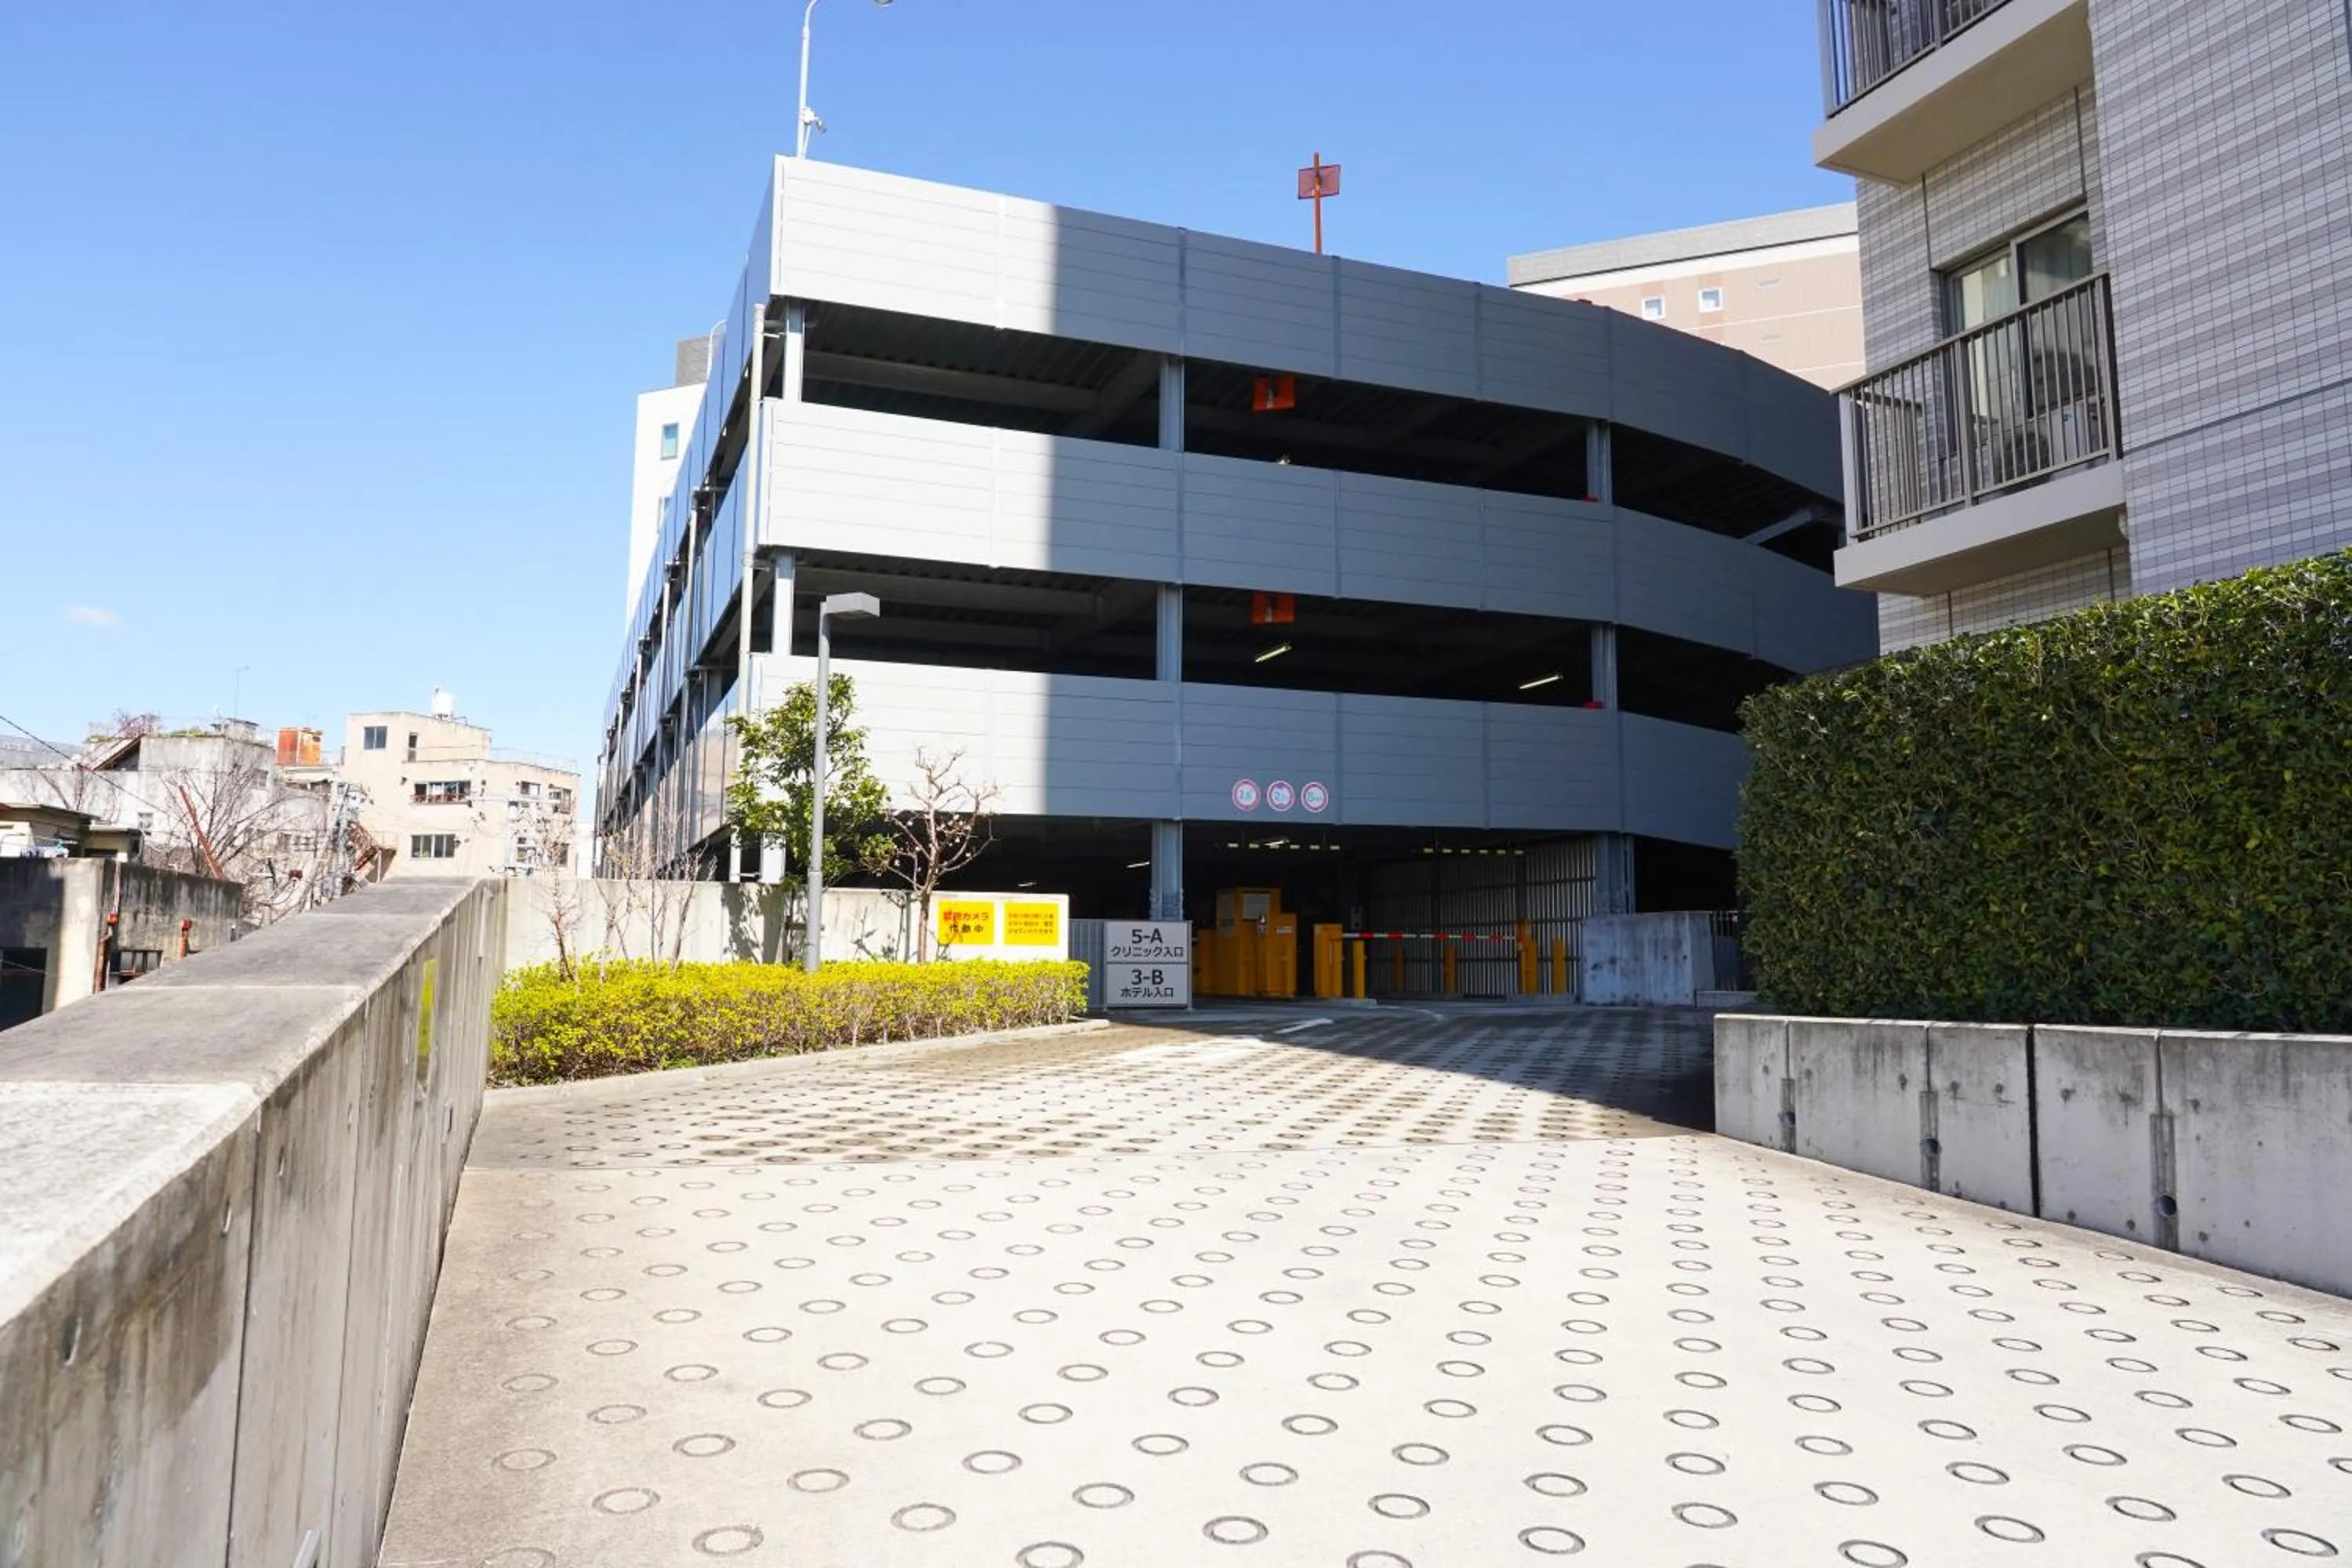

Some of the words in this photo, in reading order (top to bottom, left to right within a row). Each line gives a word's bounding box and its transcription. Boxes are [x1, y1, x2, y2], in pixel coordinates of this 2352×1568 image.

[1131, 927, 1163, 944] 5-A
[1110, 945, 1184, 957] クリニック入口
[1131, 969, 1164, 985] 3-B
[1120, 987, 1174, 998] ホテル入口
